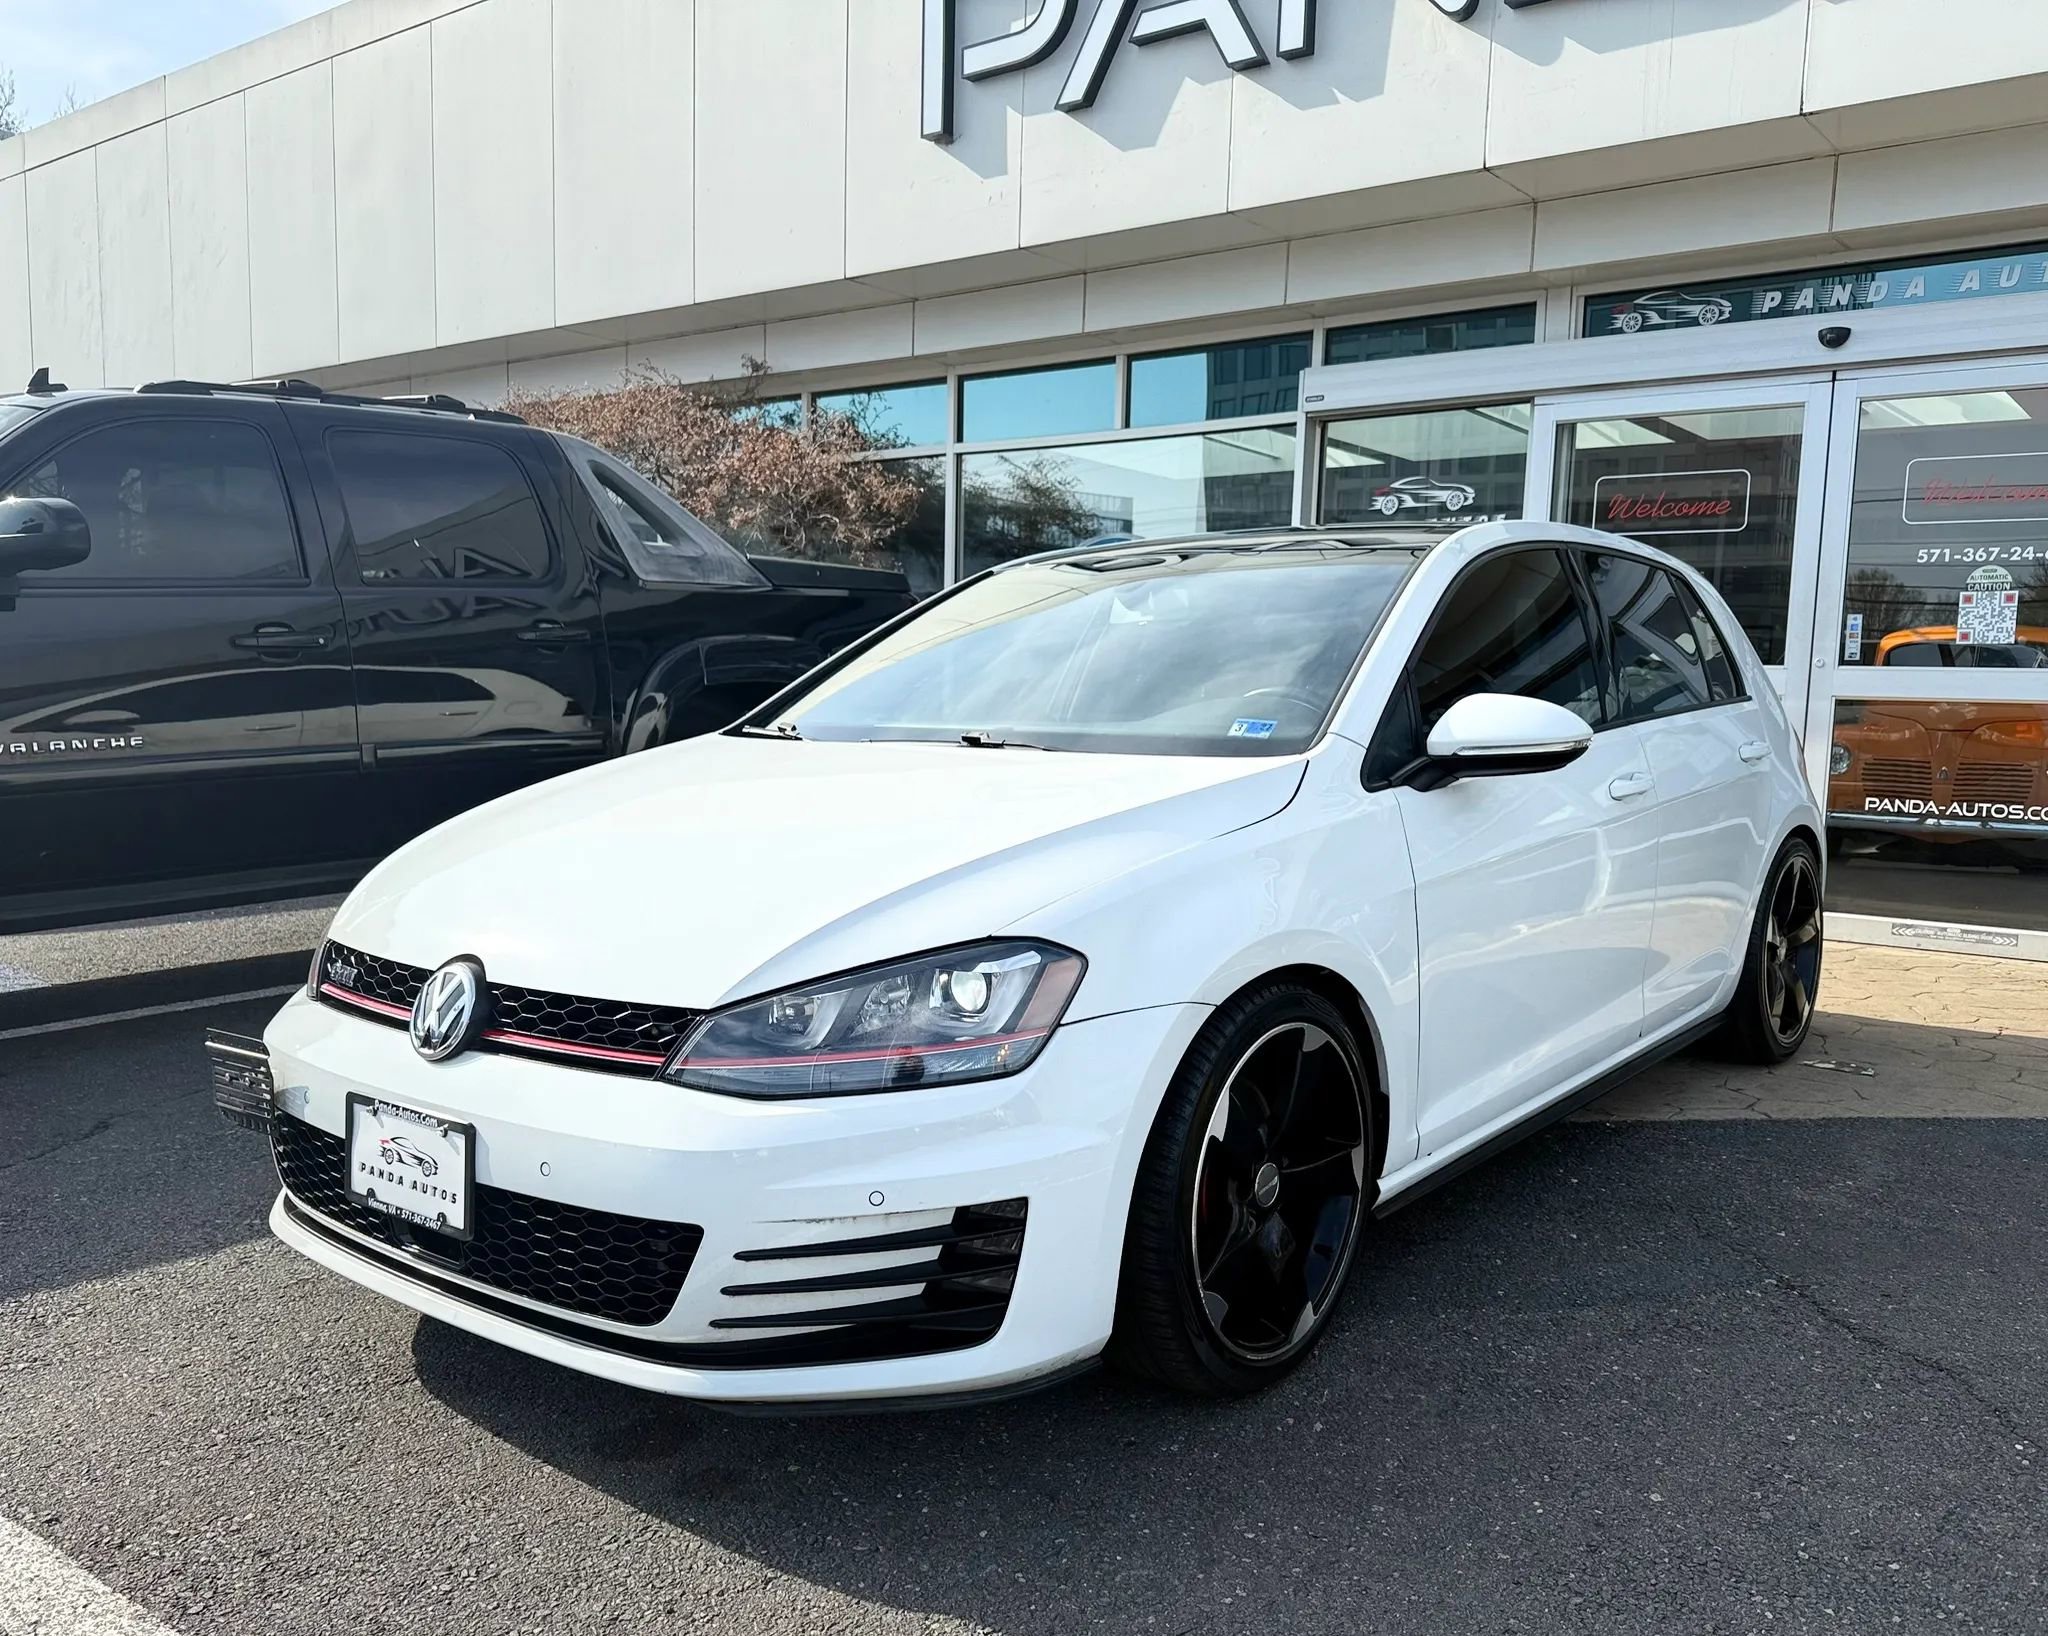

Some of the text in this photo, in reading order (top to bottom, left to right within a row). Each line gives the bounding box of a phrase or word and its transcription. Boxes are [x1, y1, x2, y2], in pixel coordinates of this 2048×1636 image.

[1756, 276, 1926, 314] PANDA
[1608, 490, 1732, 521] Welcome
[1917, 546, 2048, 564] 571-367-24-
[1967, 582, 2011, 592] CAUTION
[1970, 573, 2010, 581] AUTOMATIC
[359, 1161, 457, 1205] PANDA AUTOS
